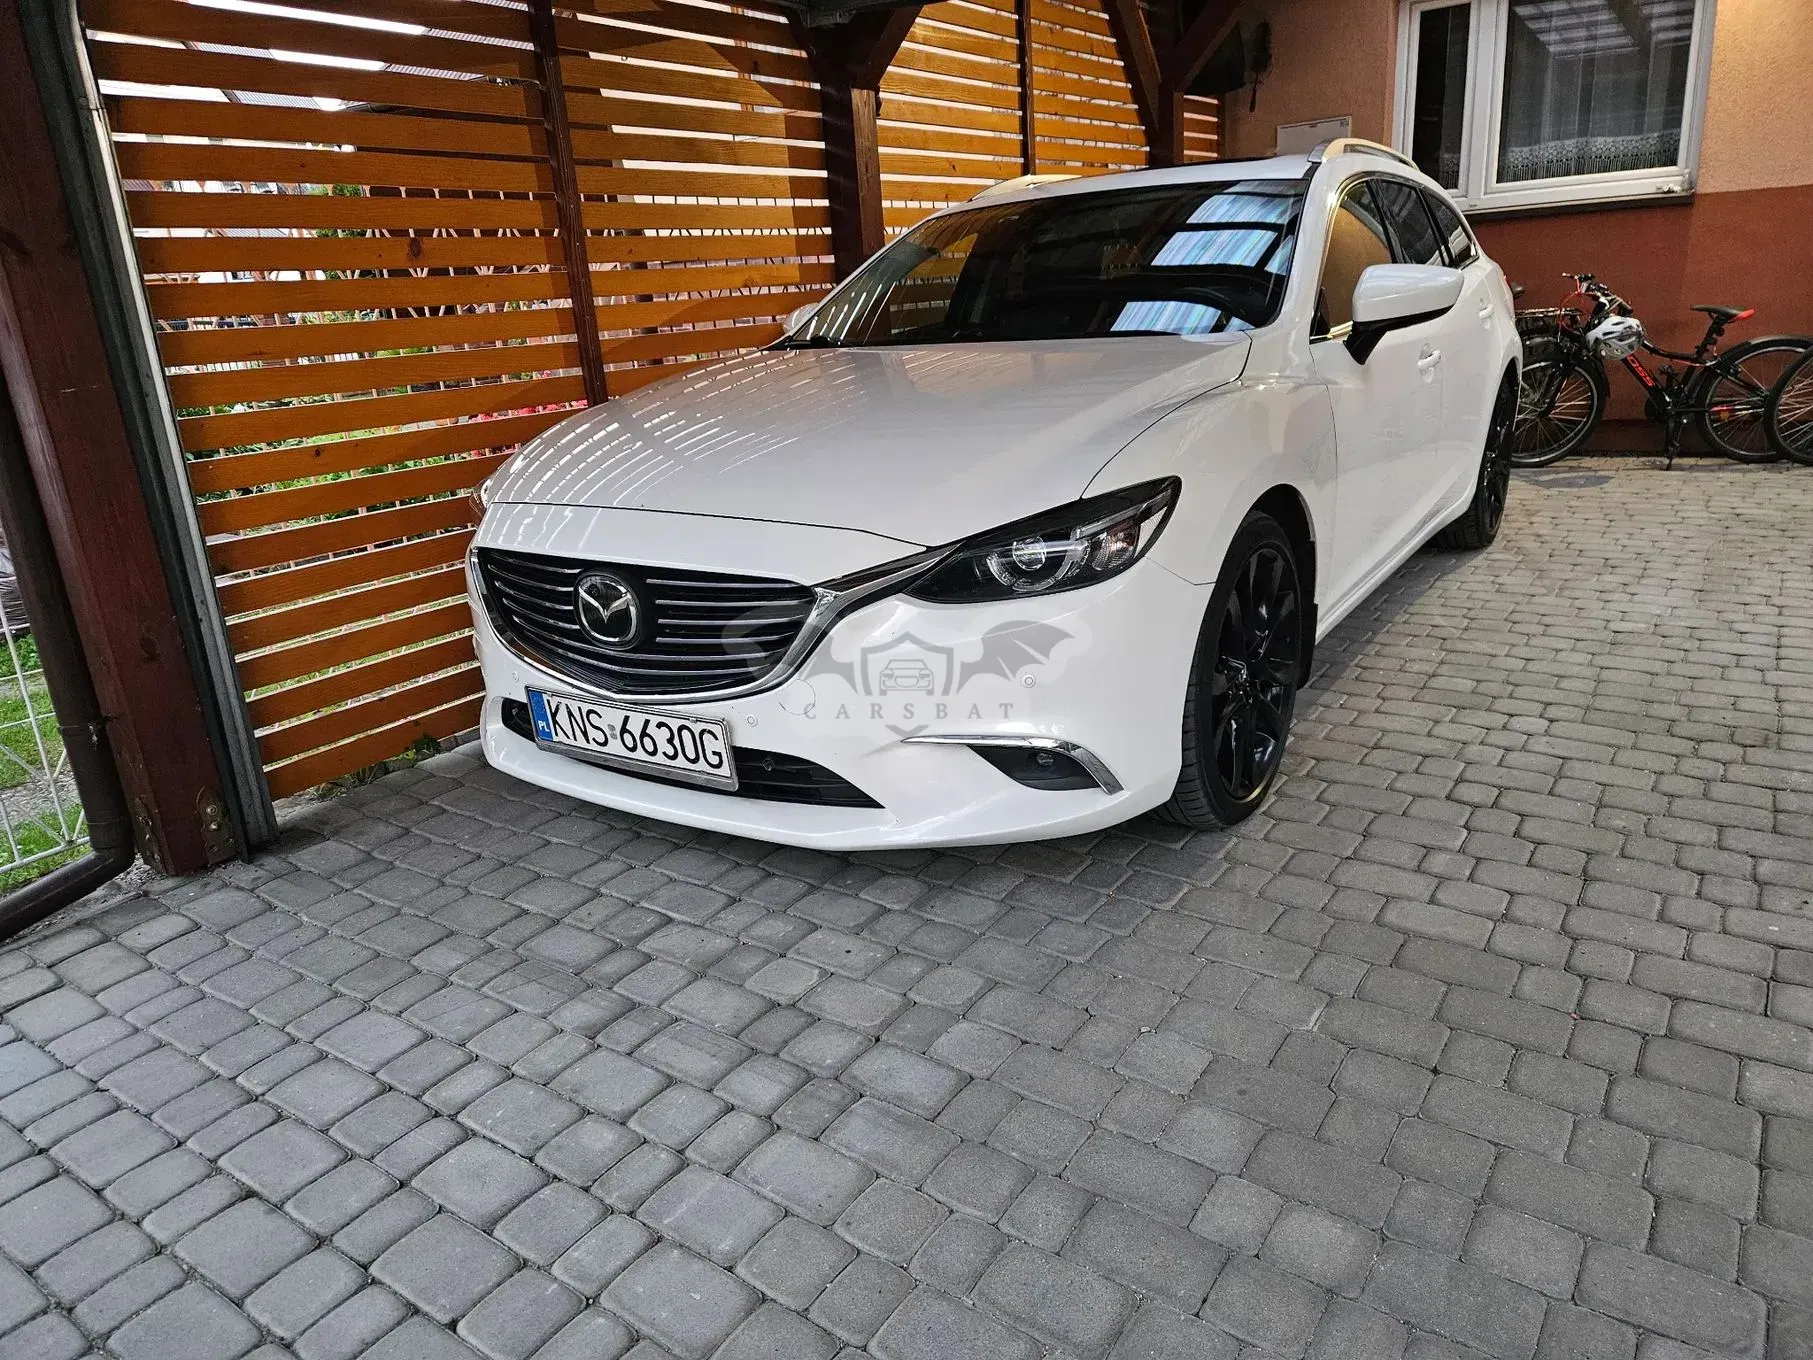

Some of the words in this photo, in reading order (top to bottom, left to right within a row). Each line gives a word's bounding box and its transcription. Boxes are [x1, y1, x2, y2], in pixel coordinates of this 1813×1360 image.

[1627, 355, 1655, 387] OSS
[538, 720, 550, 732] PL
[547, 699, 608, 747] KNS
[619, 715, 723, 769] 6630G
